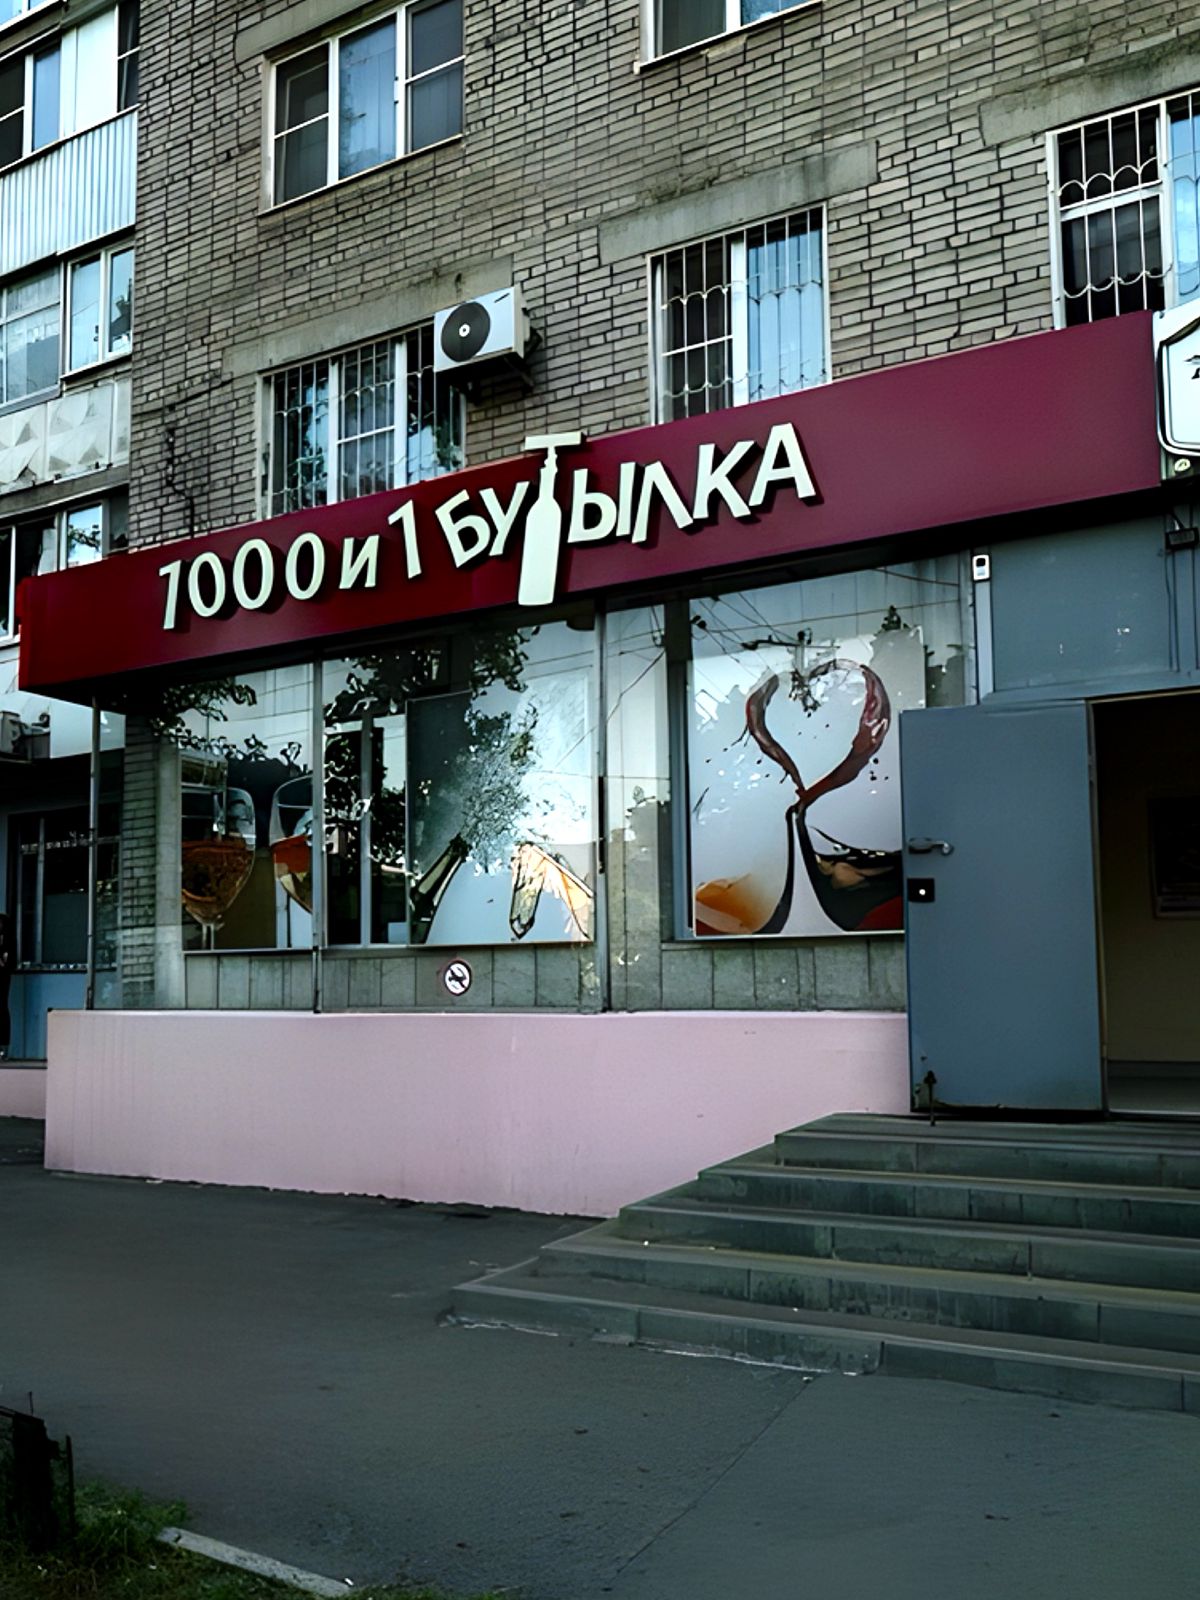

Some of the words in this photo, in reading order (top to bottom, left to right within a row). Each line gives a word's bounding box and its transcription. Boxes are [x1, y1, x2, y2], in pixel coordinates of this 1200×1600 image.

[159, 532, 325, 630] 1000
[388, 500, 423, 579] 1
[435, 422, 816, 606] БУТЫЛКА
